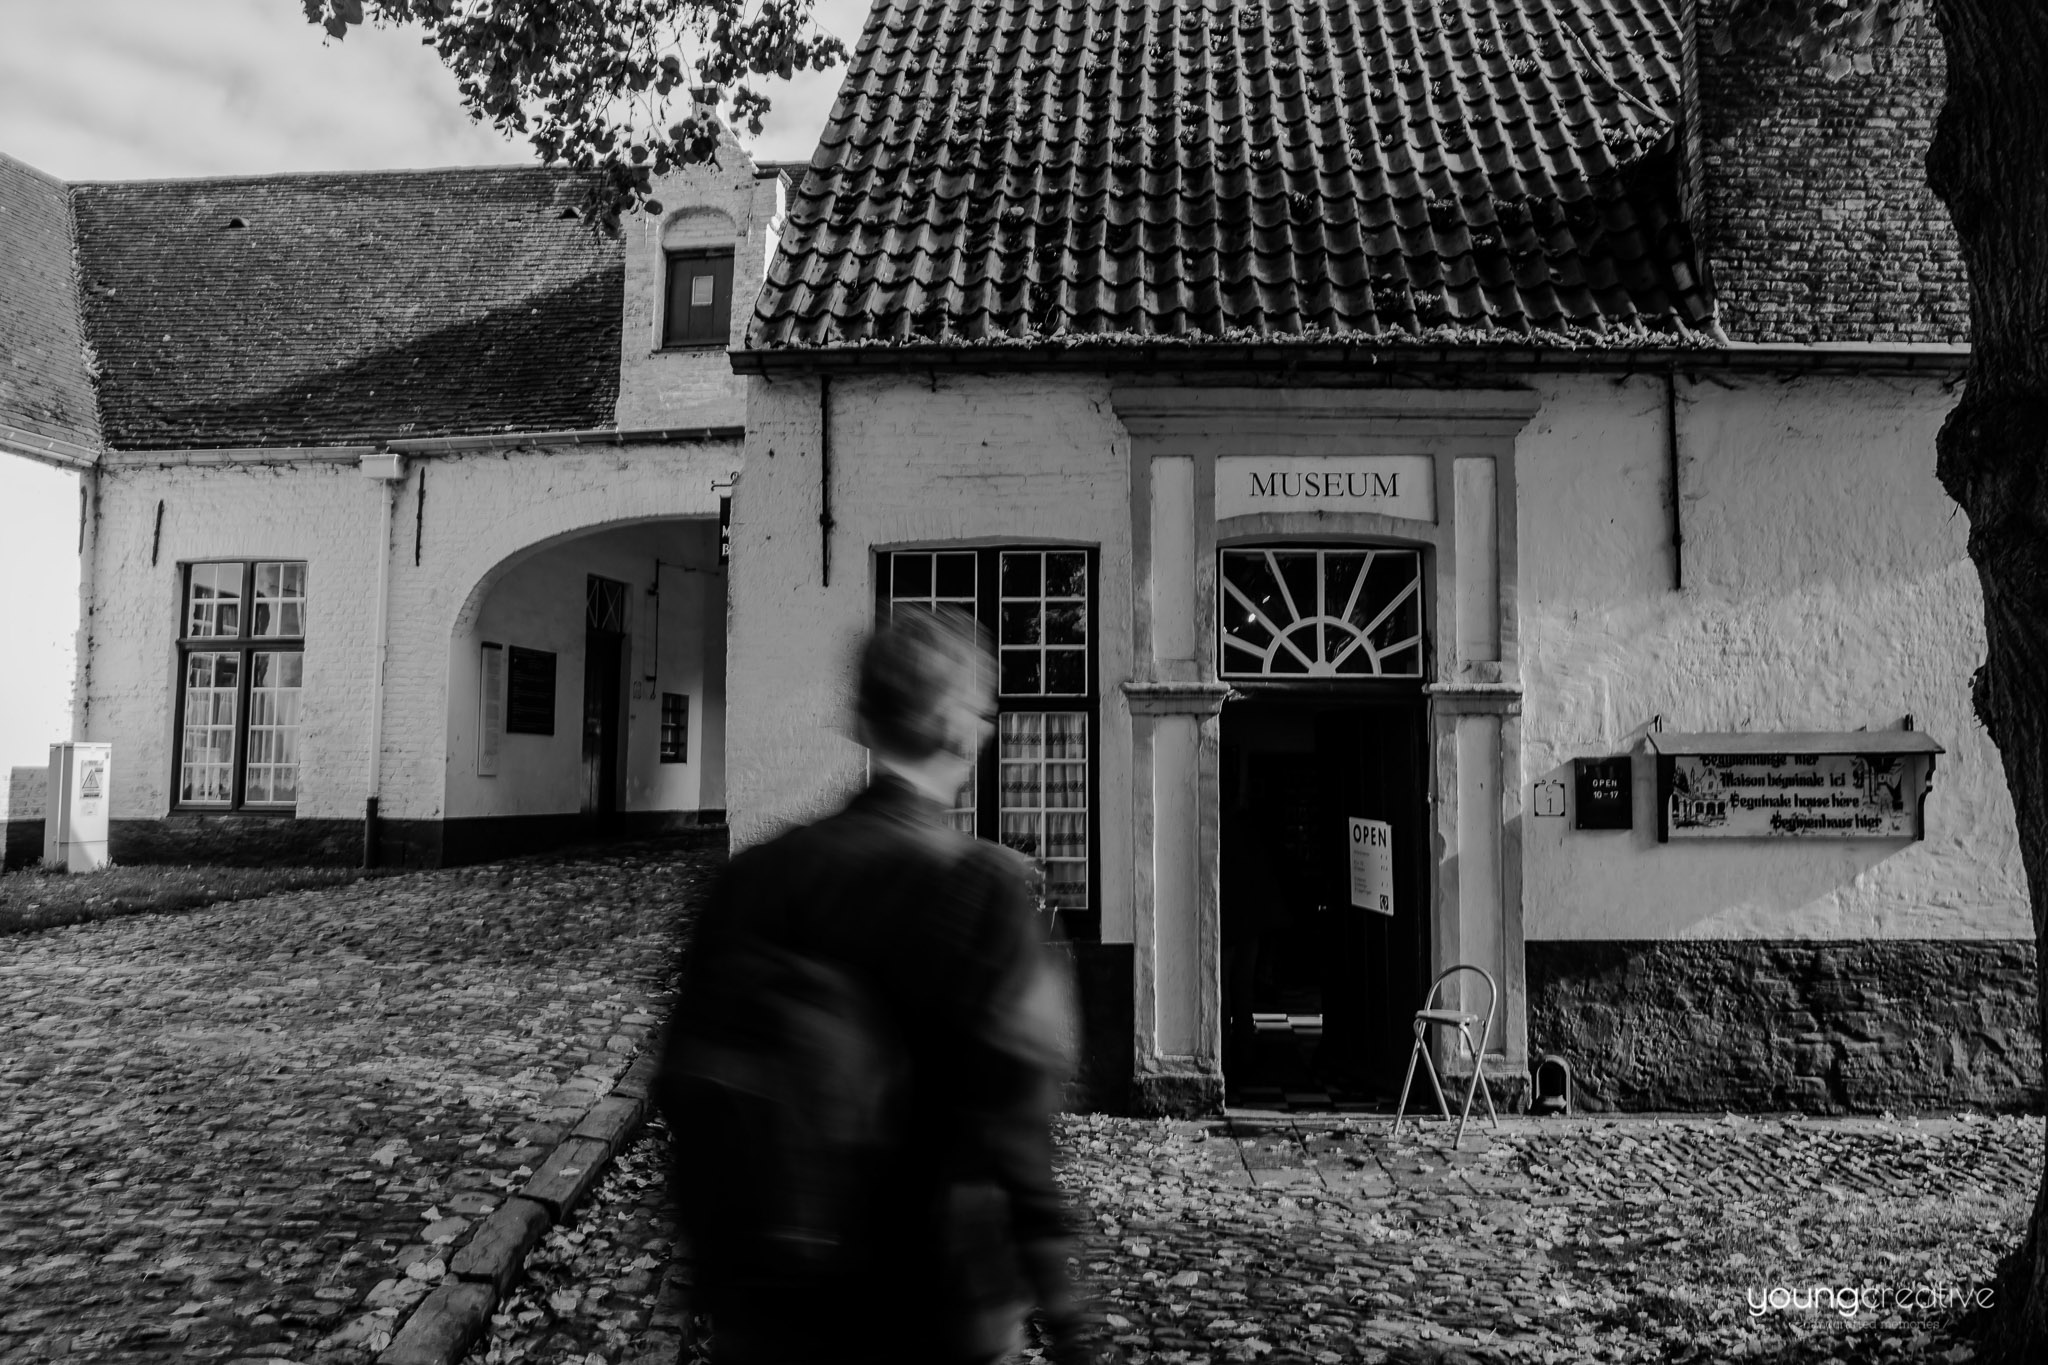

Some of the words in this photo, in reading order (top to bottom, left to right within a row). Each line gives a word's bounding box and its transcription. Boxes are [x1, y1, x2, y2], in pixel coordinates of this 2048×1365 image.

[1249, 472, 1400, 497] MUSEUM
[1592, 779, 1617, 788] OPEN
[1720, 770, 1765, 787] Maison
[1829, 772, 1846, 787] ici
[1547, 797, 1552, 813] 1
[1794, 793, 1829, 808] house
[1831, 793, 1860, 808] here
[1855, 813, 1882, 829] hier
[1353, 824, 1386, 848] OPEN
